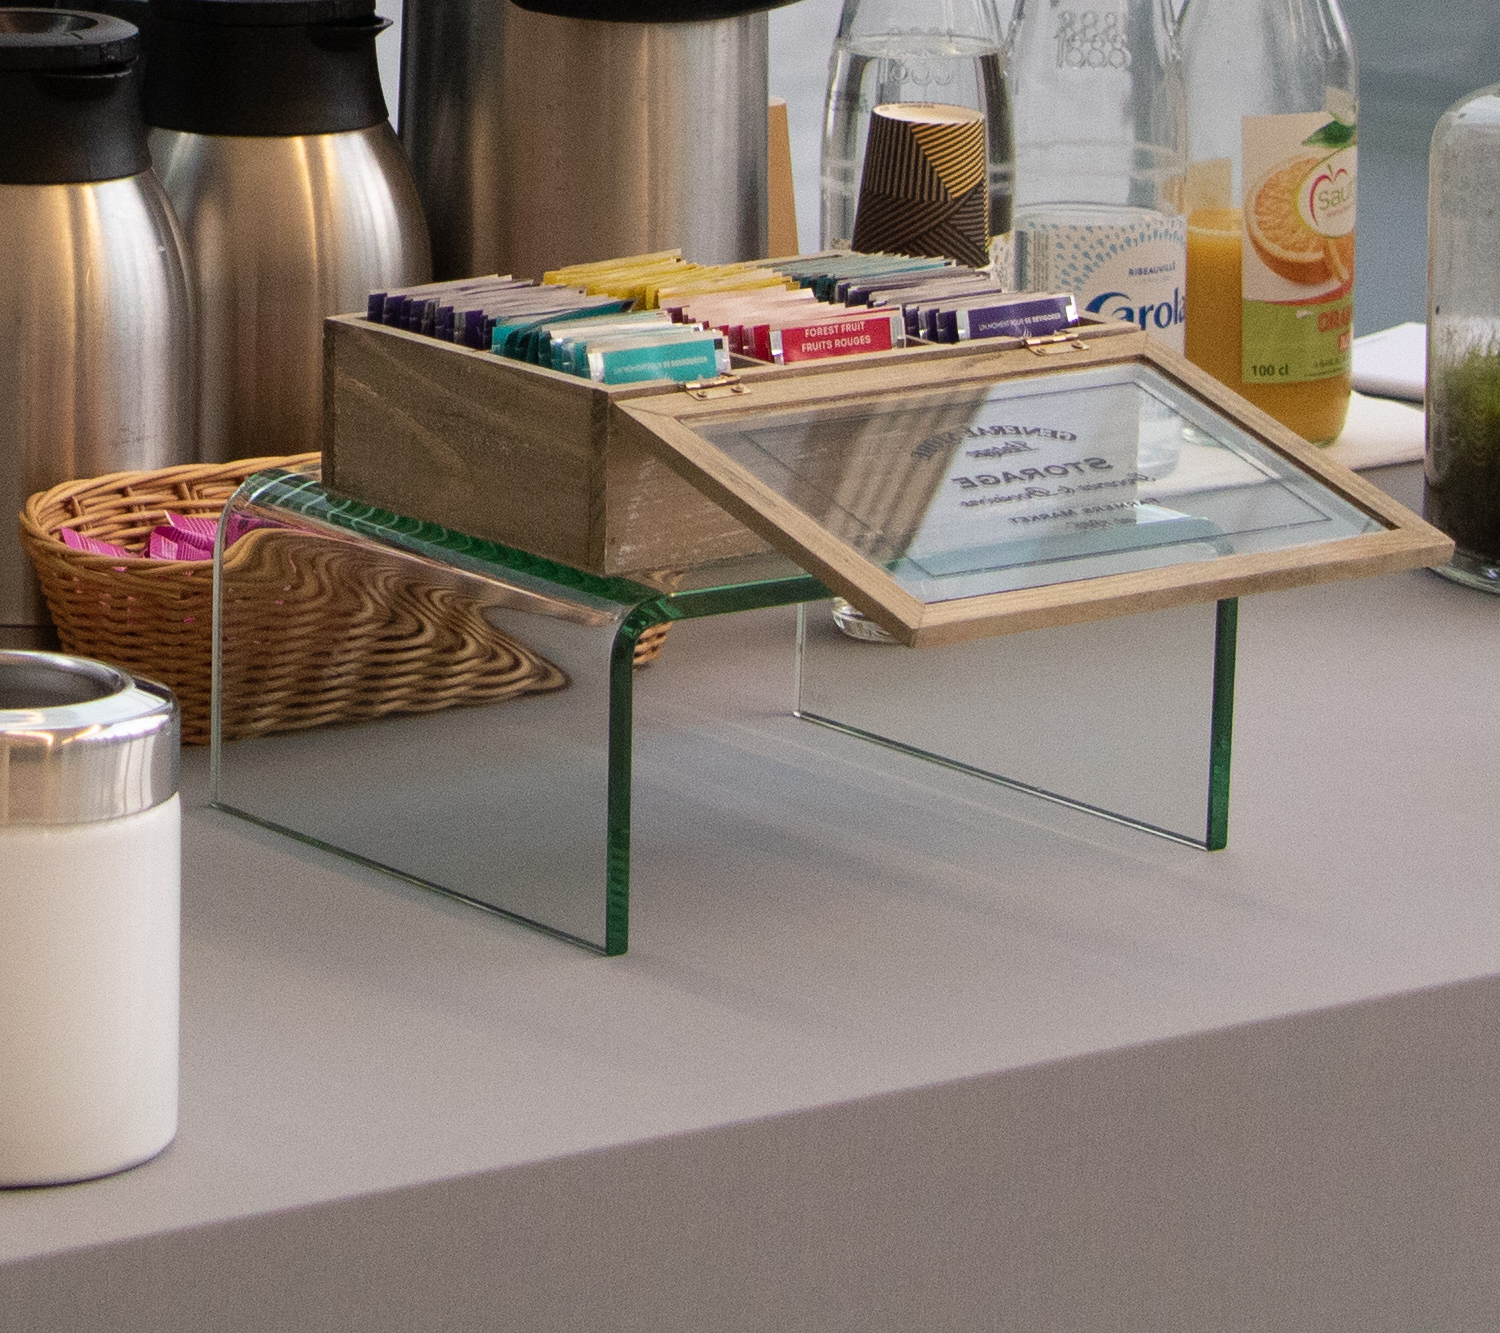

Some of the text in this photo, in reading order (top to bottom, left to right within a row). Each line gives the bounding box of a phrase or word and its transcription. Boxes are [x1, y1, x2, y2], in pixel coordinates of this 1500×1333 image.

[805, 321, 865, 338] FOREST FRUIT
[801, 335, 871, 352] FRUITS ROUGES
[1251, 364, 1275, 377] 100
[1278, 363, 1289, 375] cl
